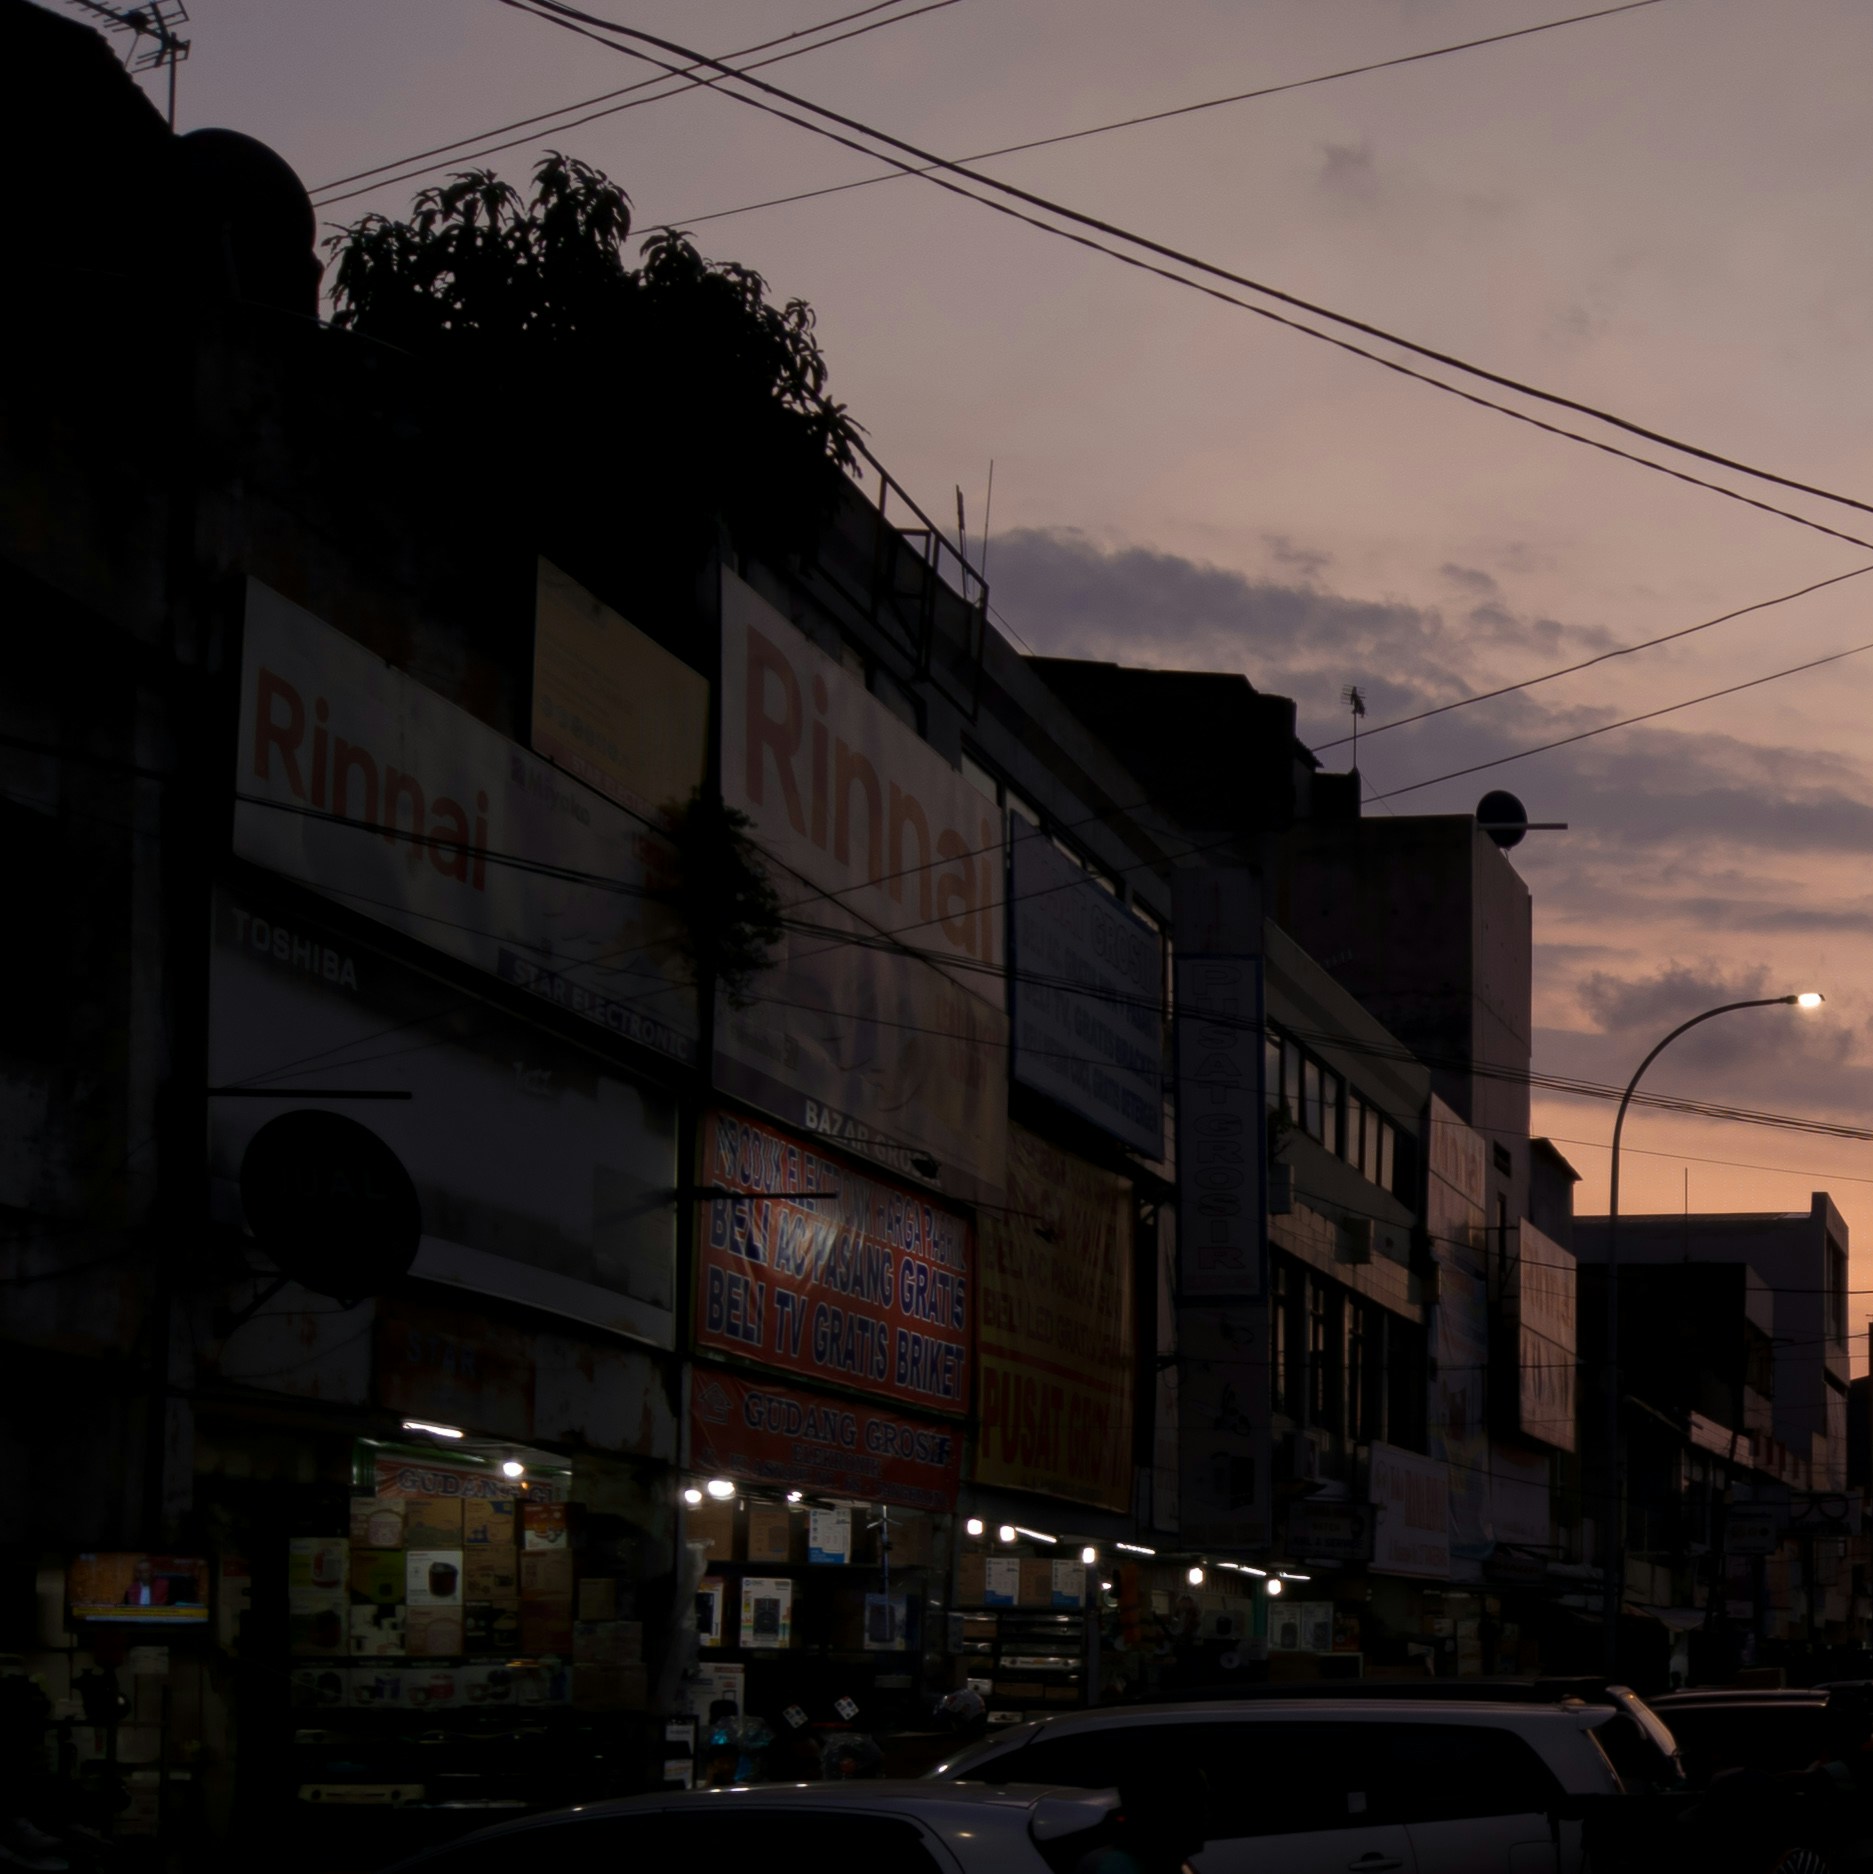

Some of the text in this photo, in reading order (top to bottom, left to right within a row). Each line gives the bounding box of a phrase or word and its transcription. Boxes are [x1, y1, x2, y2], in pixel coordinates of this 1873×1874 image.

[254, 666, 489, 891] Rinnai
[746, 624, 993, 967] Rinnai
[232, 907, 359, 991] TOSHIBA
[511, 958, 568, 1004] STAR
[571, 988, 690, 1060] ELECTRONIC
[1192, 964, 1243, 1104] PUSAT
[805, 1098, 868, 1156] BAZAR
[1193, 1112, 1246, 1270] GROSIR
[709, 1179, 966, 1334] BELI AC PASANG GRATIS
[705, 1262, 965, 1404] BELI TV GRATIS BRIKET
[742, 1389, 857, 1449] GUDANG
[982, 1361, 1063, 1474] PUSAT
